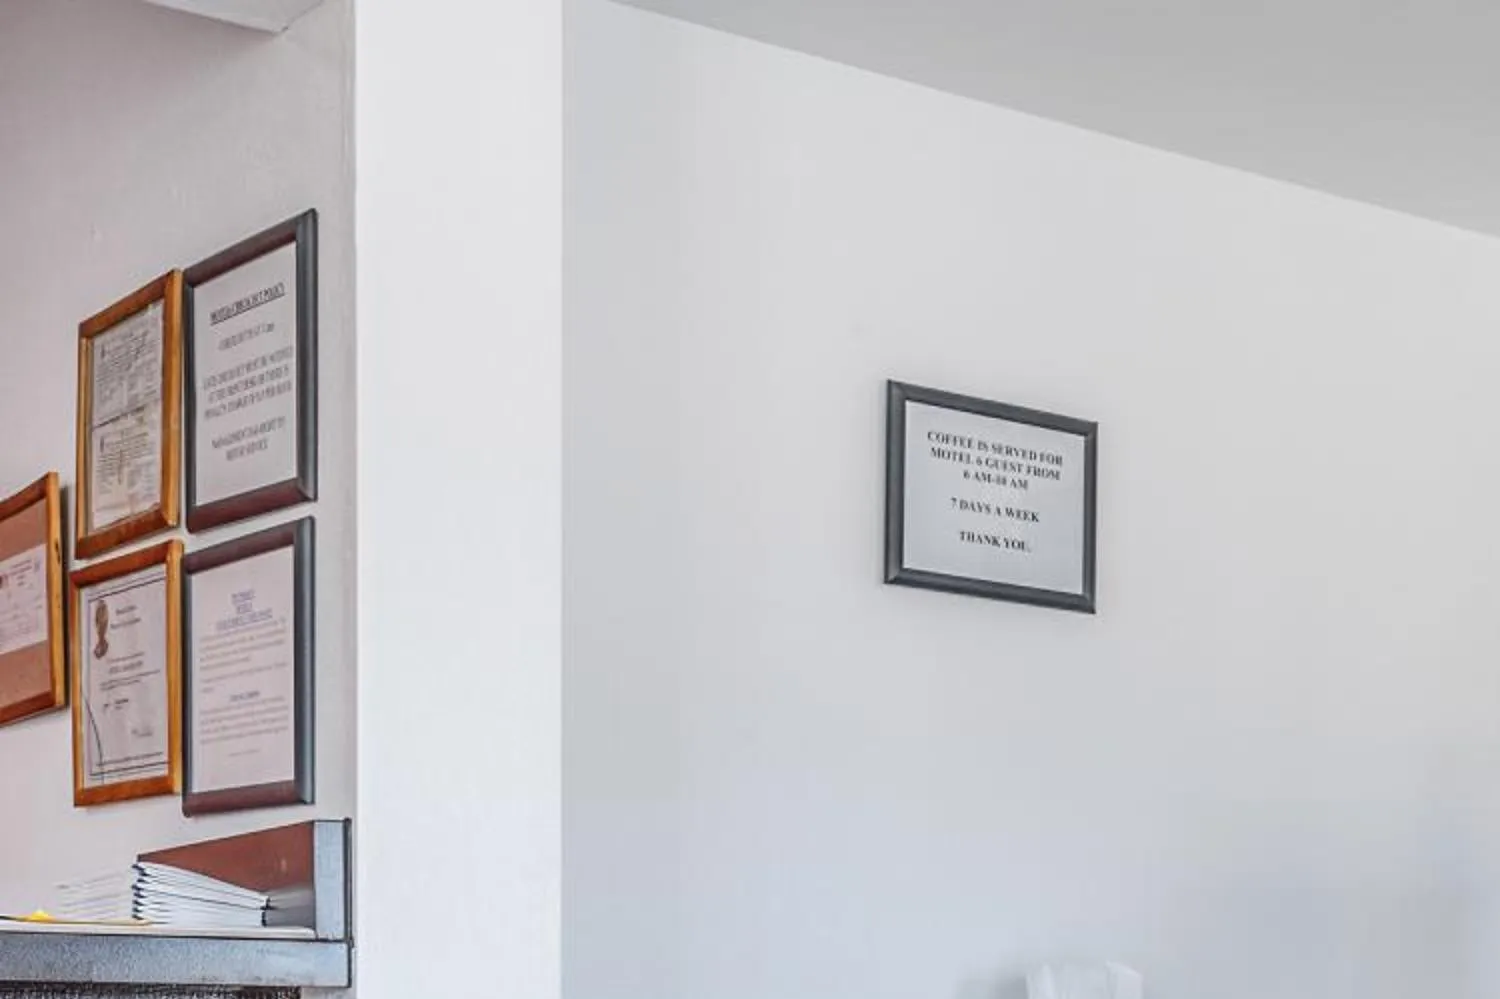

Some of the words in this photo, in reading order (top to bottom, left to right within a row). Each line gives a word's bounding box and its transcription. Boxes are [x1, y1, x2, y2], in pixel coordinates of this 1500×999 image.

[927, 431, 972, 449] COFFEE
[978, 440, 989, 452] IS
[991, 442, 1037, 461] SERVED
[1039, 452, 1063, 467] FOR
[930, 447, 971, 464] MOTEL
[985, 457, 1023, 473] GUEST
[1026, 465, 1061, 481] FROM
[1009, 478, 1029, 491] AM
[959, 499, 991, 514] DAYS
[994, 506, 1002, 516] A
[1004, 507, 1040, 523] WEEK
[959, 530, 1001, 548] THANK
